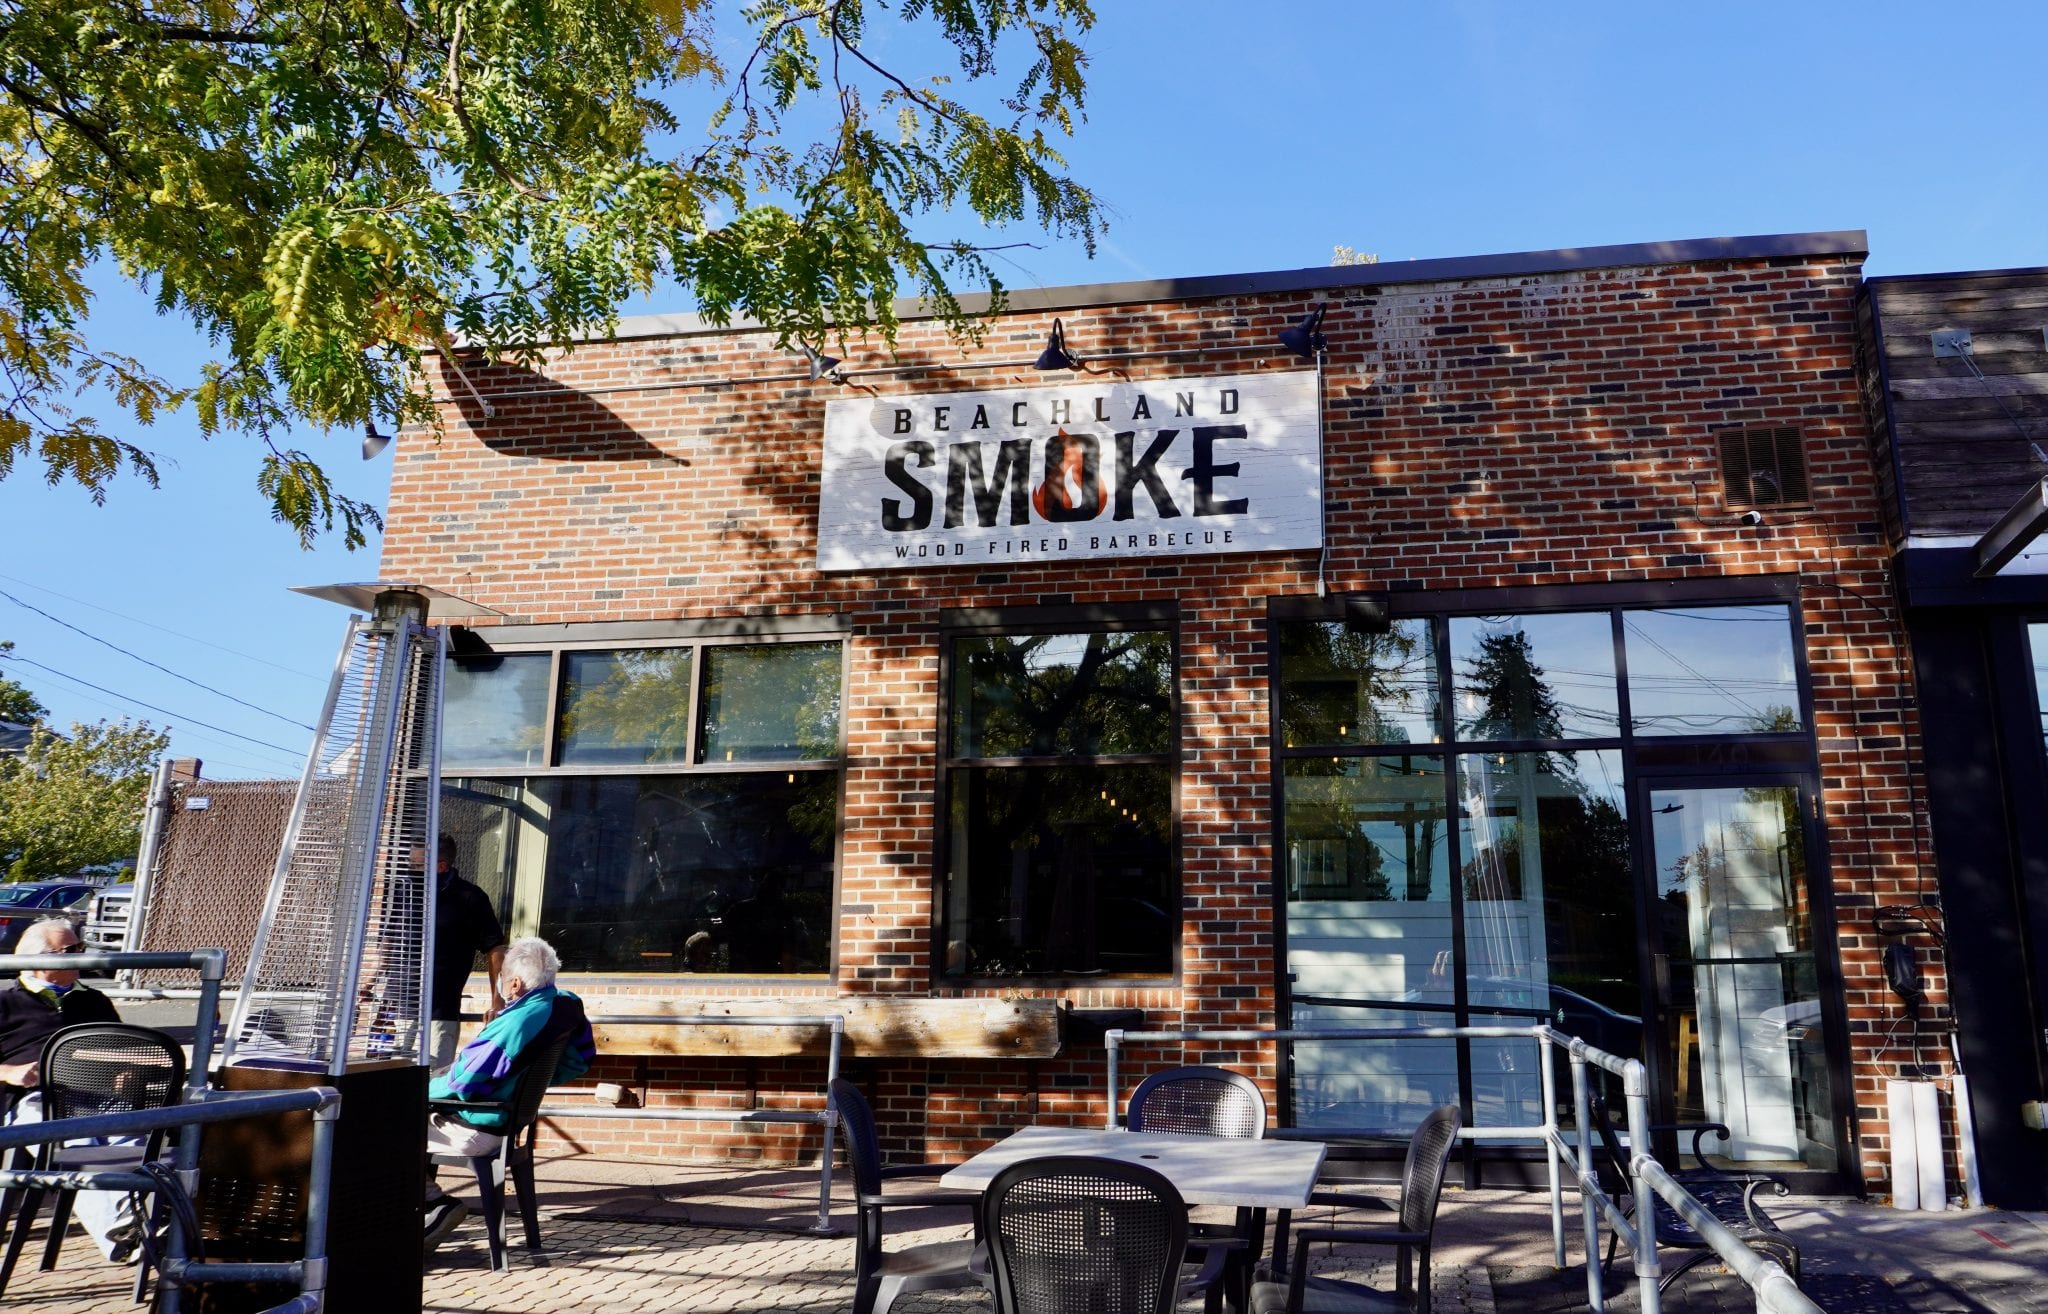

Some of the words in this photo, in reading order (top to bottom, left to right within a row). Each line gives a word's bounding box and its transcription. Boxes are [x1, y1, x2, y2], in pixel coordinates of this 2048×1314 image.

[893, 389, 1239, 434] BEACHLAND
[881, 424, 1249, 532] SMOKE
[895, 543, 964, 558] WOOD
[988, 538, 1068, 554] FIRED
[1090, 530, 1233, 550] BARBECUE
